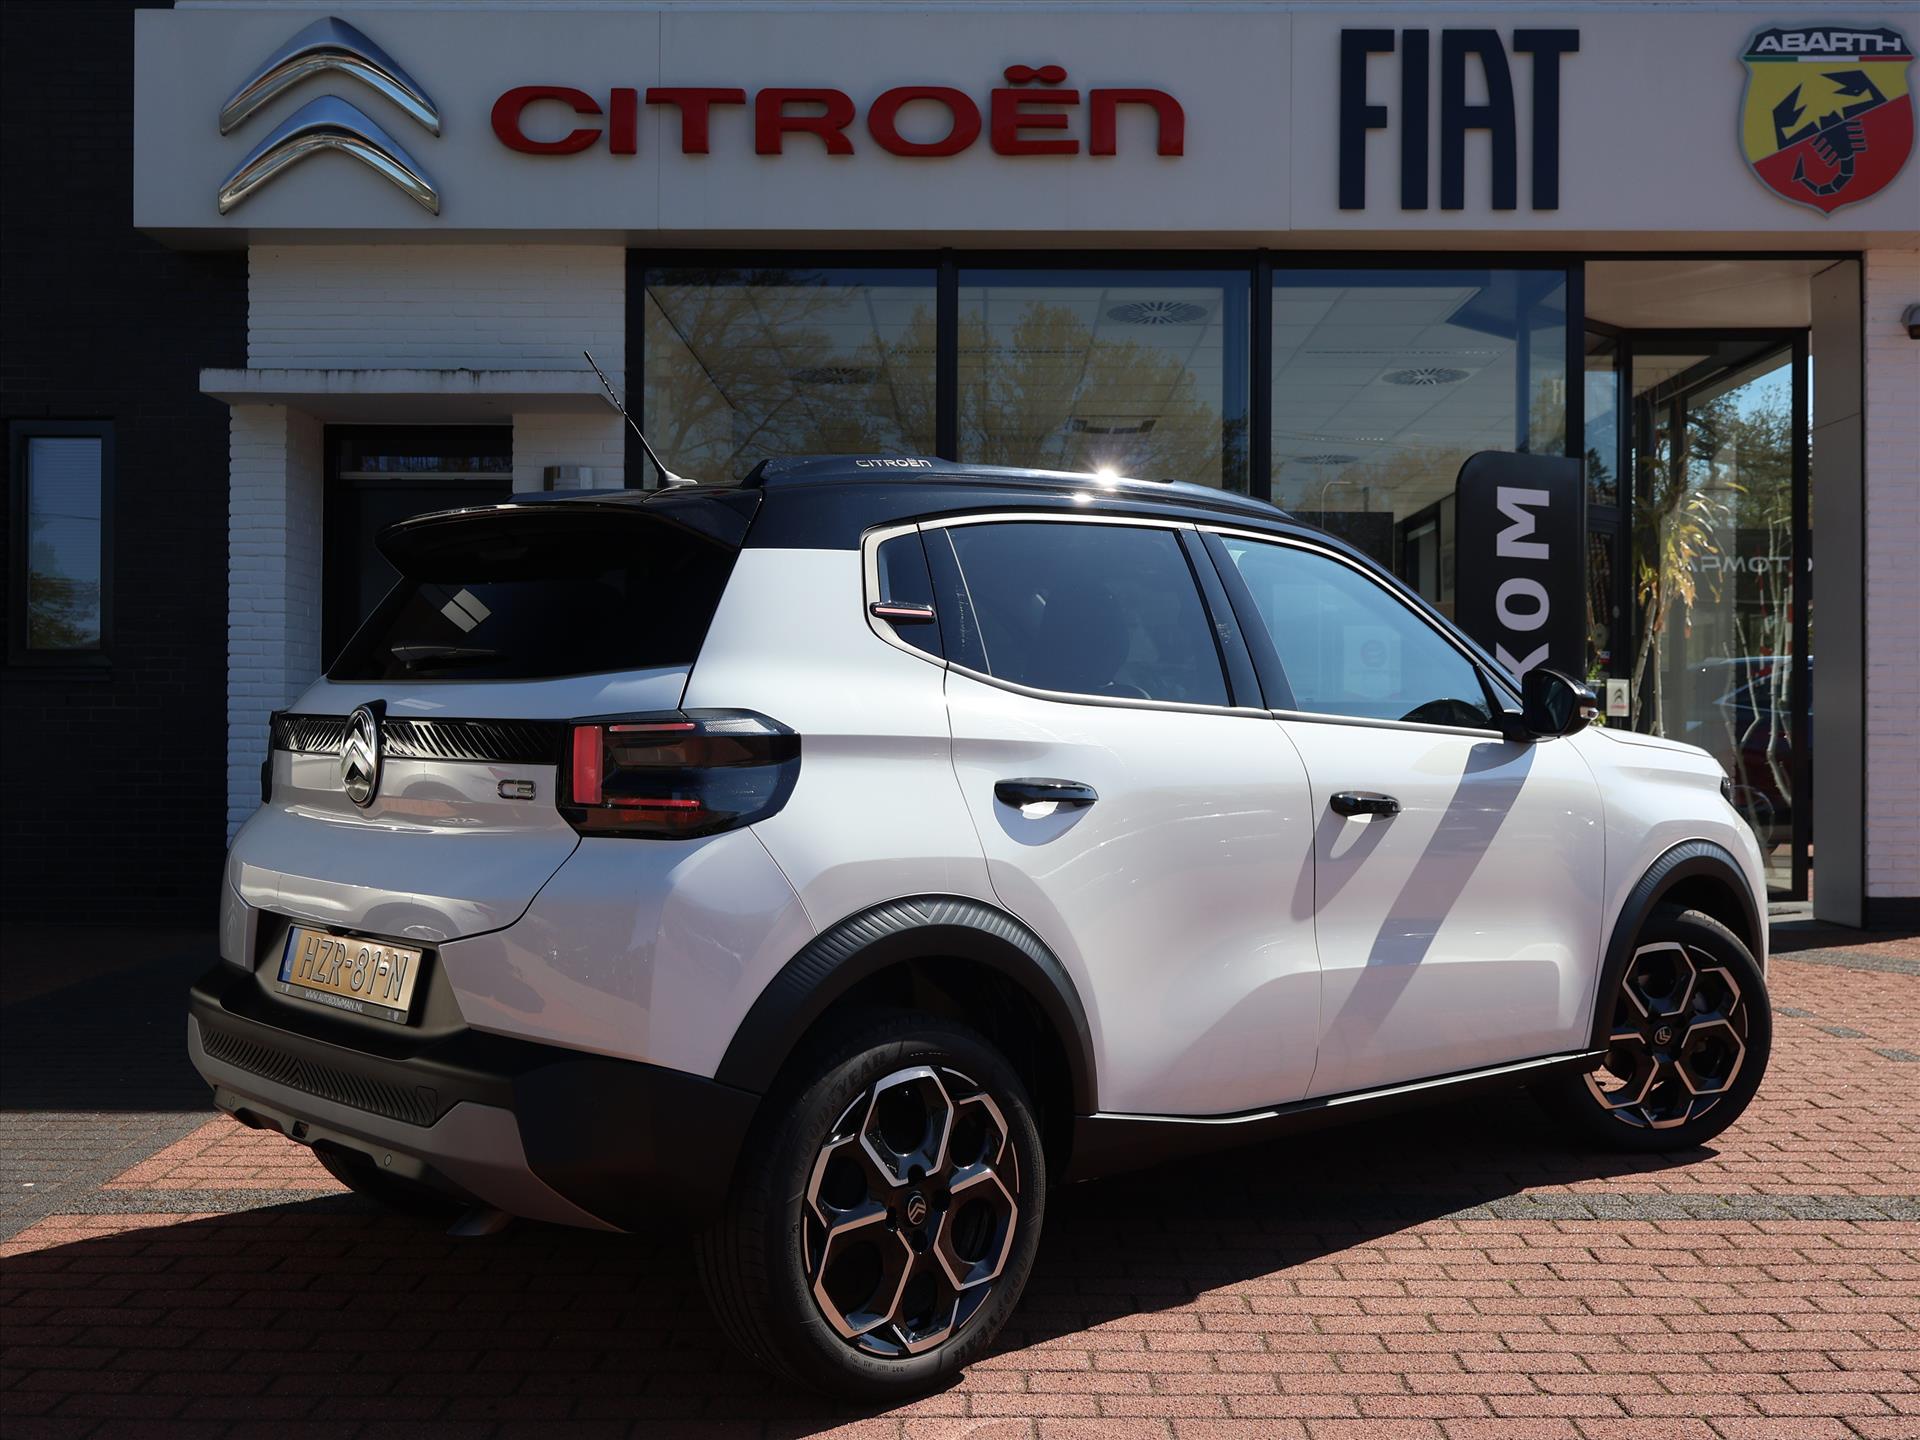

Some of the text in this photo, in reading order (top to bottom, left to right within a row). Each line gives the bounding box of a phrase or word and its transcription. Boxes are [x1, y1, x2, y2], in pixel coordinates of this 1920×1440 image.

[1756, 31, 1901, 52] ABARTH
[491, 65, 1185, 157] CITROËN
[1339, 29, 1580, 210] FIAT
[497, 779, 536, 801] C3
[298, 936, 410, 1002] HZR-81-N
